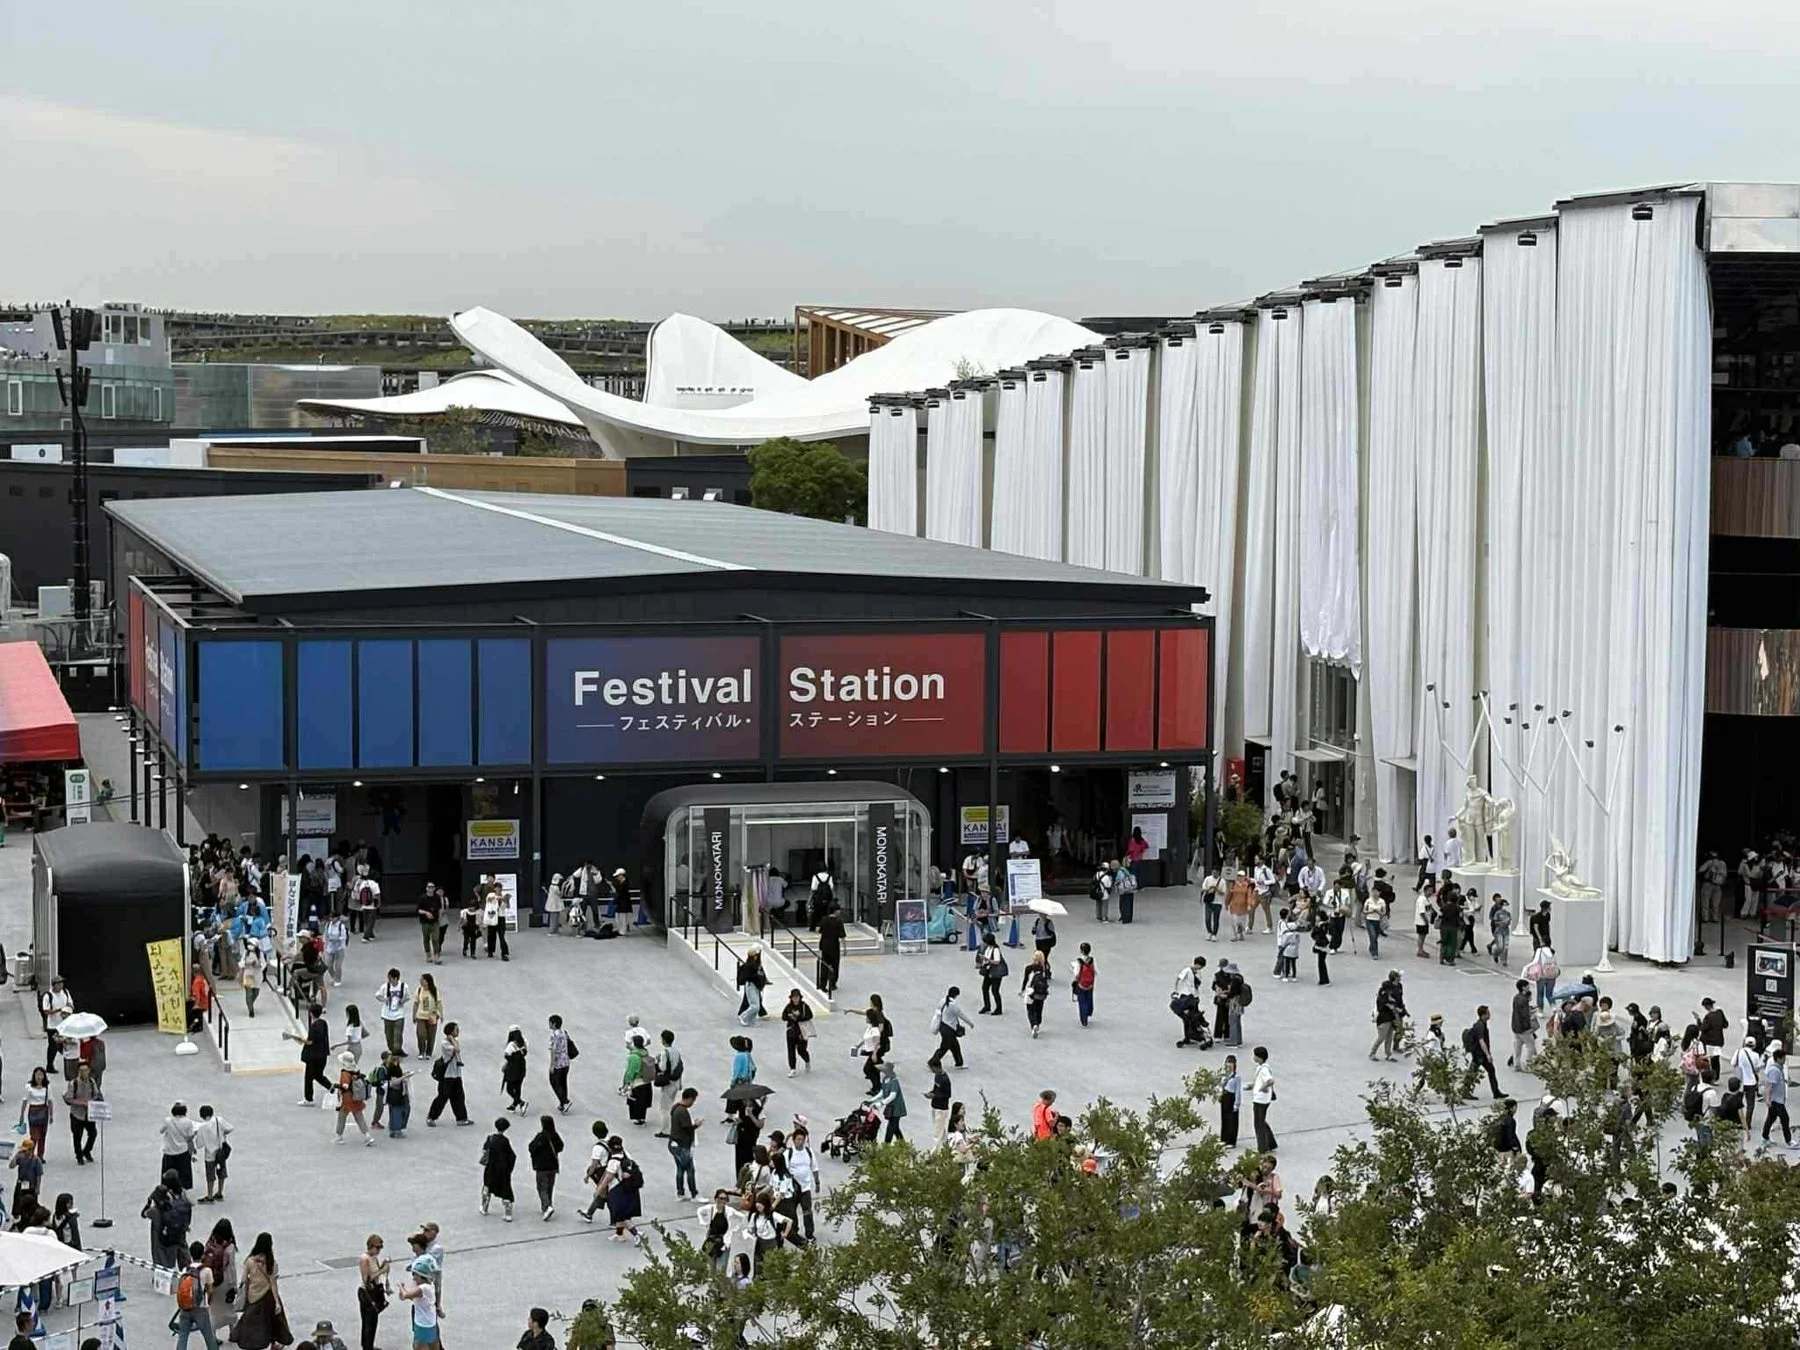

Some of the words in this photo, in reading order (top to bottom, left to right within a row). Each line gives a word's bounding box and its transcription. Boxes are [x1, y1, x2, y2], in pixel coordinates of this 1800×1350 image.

[574, 669, 752, 706] Festival
[789, 666, 945, 703] Station
[789, 710, 897, 728] ステーション
[470, 837, 517, 847] KANSAI
[963, 823, 1006, 832] KANAI
[711, 831, 723, 910] MONOKATARI
[876, 826, 887, 903] MONOKATARI
